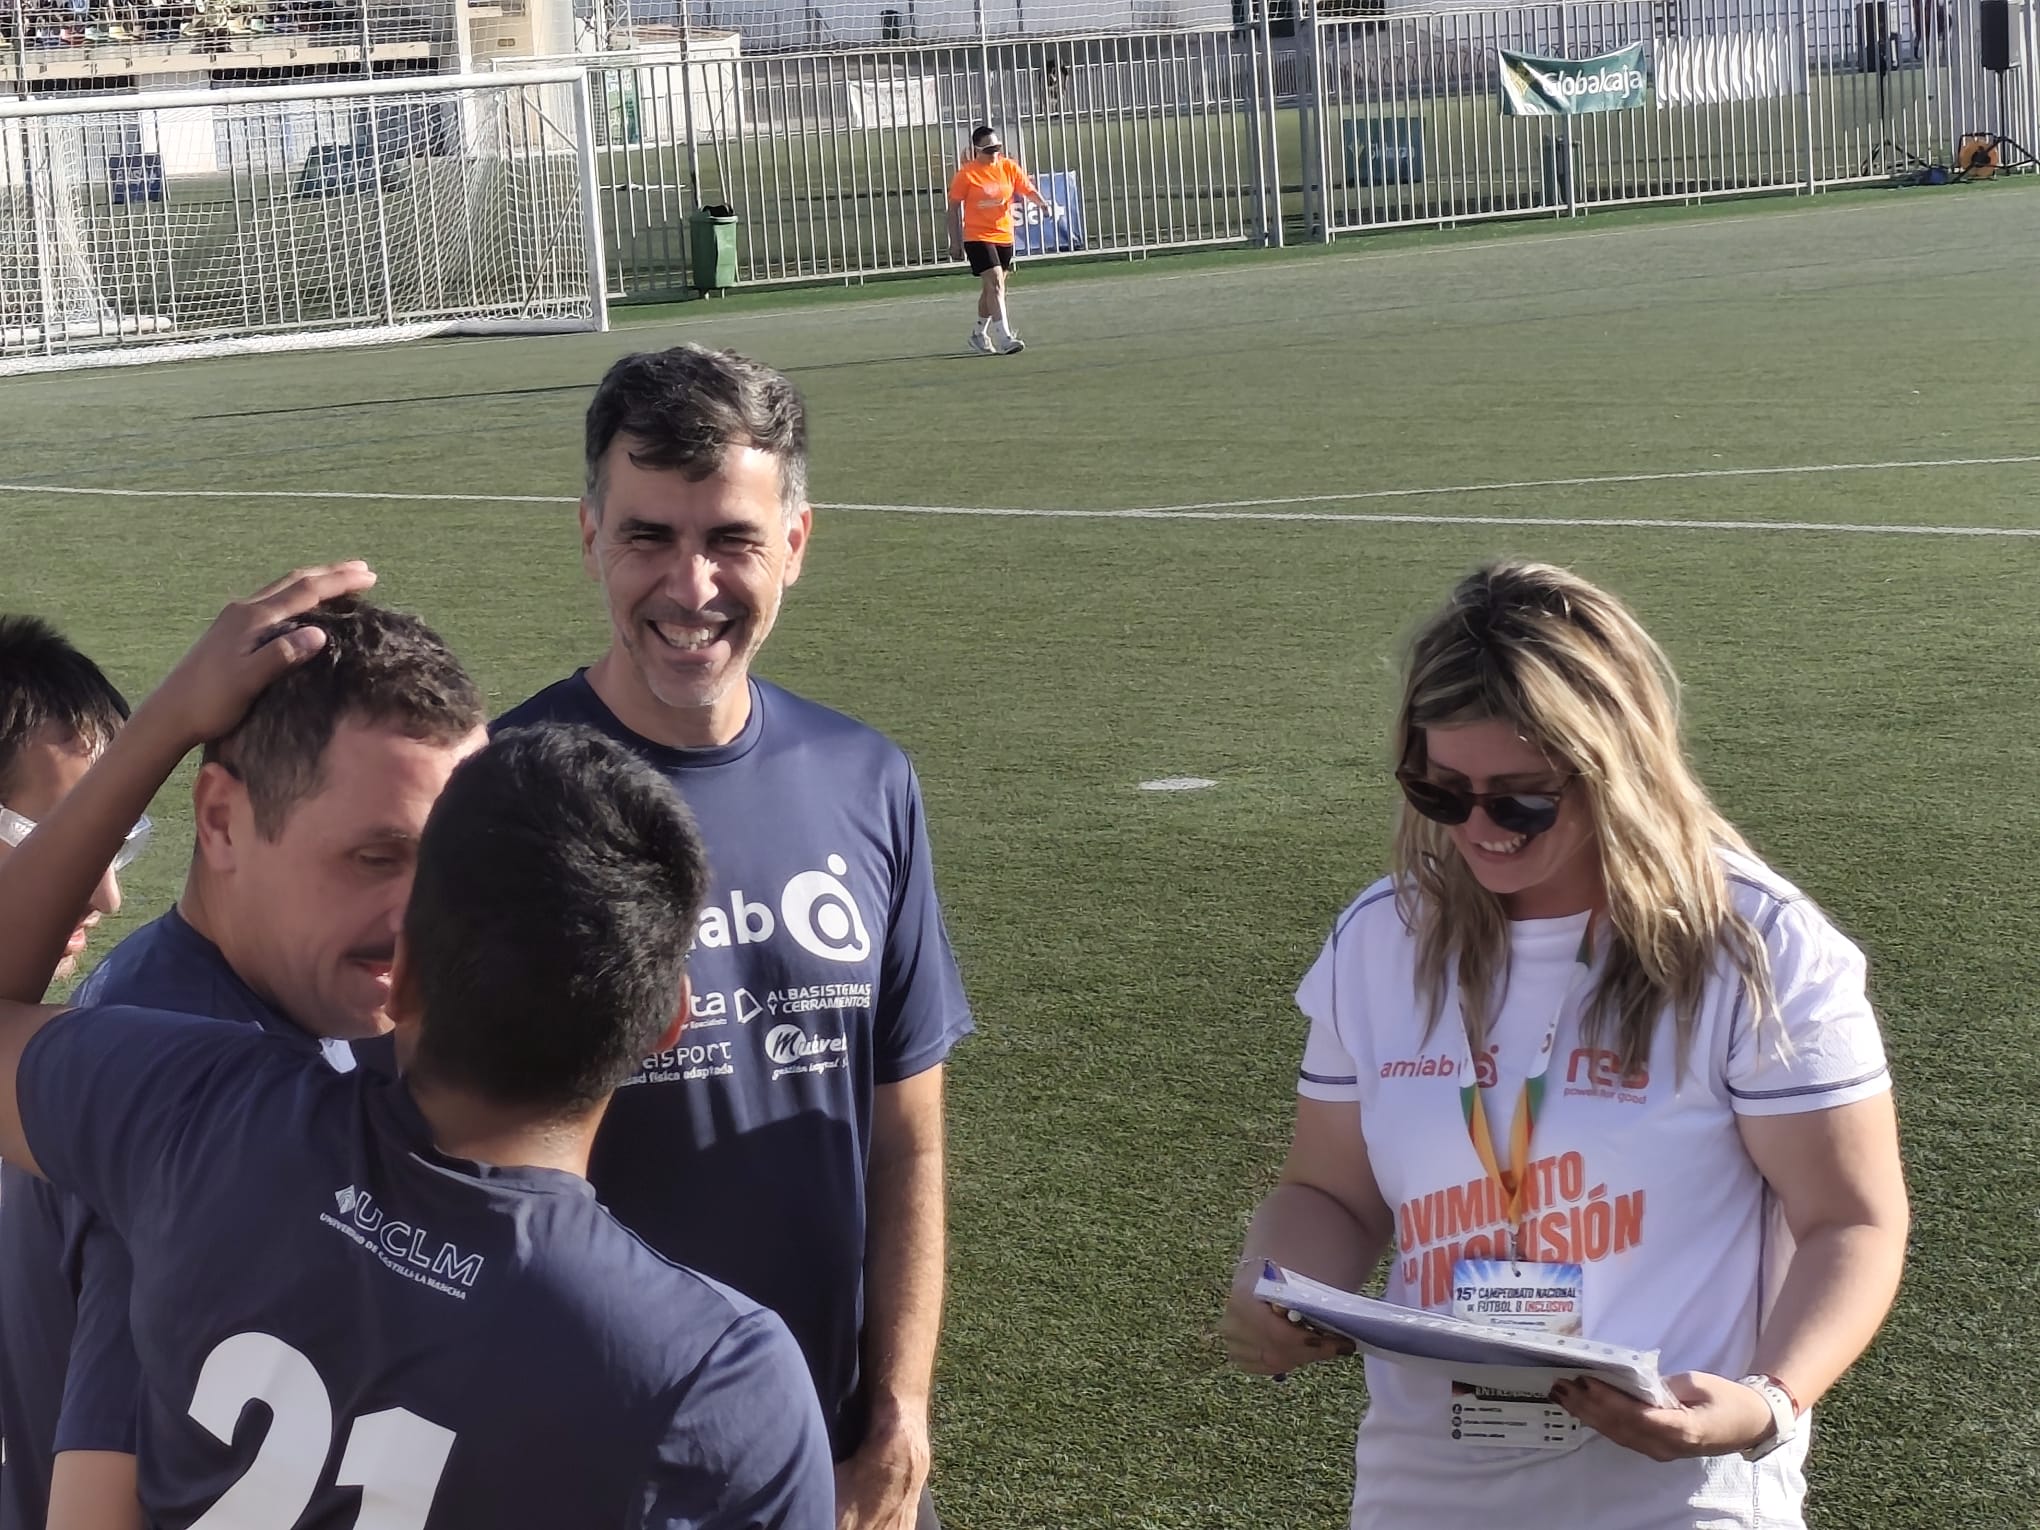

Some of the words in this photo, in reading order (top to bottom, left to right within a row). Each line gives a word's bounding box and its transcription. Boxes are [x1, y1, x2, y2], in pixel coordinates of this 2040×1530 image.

[1542, 64, 1643, 99] Globalcaja
[689, 889, 775, 950] ab
[766, 983, 872, 1003] ALBASISTEMAS
[767, 1003, 777, 1016] Y
[1380, 1054, 1454, 1080] amiab
[1400, 1150, 1583, 1254] OVIMINTO
[354, 1190, 485, 1287] UCLM
[1524, 1300, 1574, 1313] INCLUSIVO
[1535, 1287, 1577, 1299] NACIONAL
[187, 1331, 458, 1530] 21
